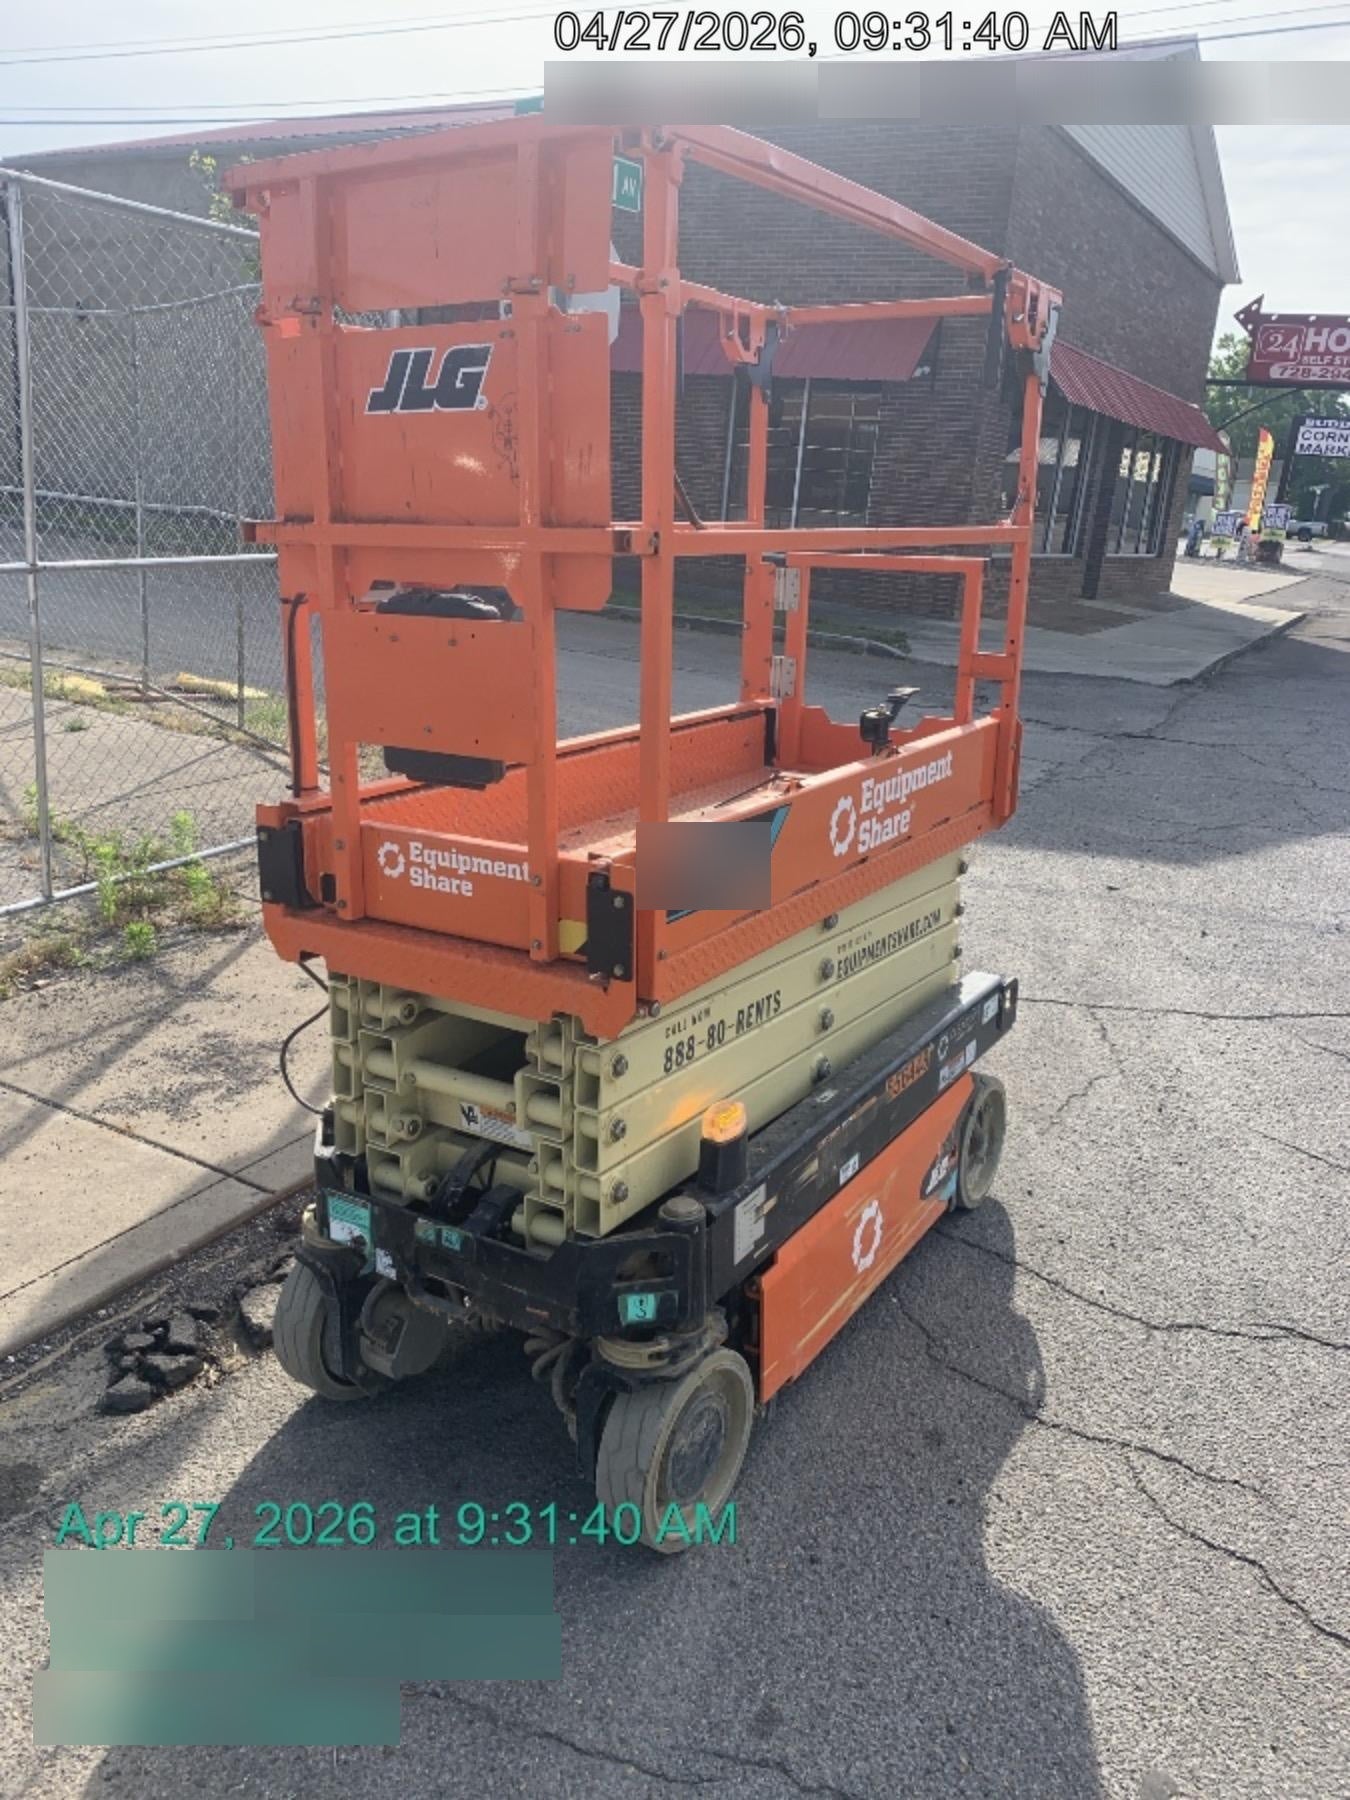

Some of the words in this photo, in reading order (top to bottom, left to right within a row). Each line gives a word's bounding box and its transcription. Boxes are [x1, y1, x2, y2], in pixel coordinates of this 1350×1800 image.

[1267, 332, 1299, 359] 24
[1301, 355, 1332, 366] SELF
[364, 343, 494, 414] JLG
[860, 749, 953, 815] Equipment
[857, 808, 912, 854] Share
[408, 841, 530, 883] Equipment
[408, 866, 474, 898] Share
[663, 989, 781, 1074] 888-80-RENTS
